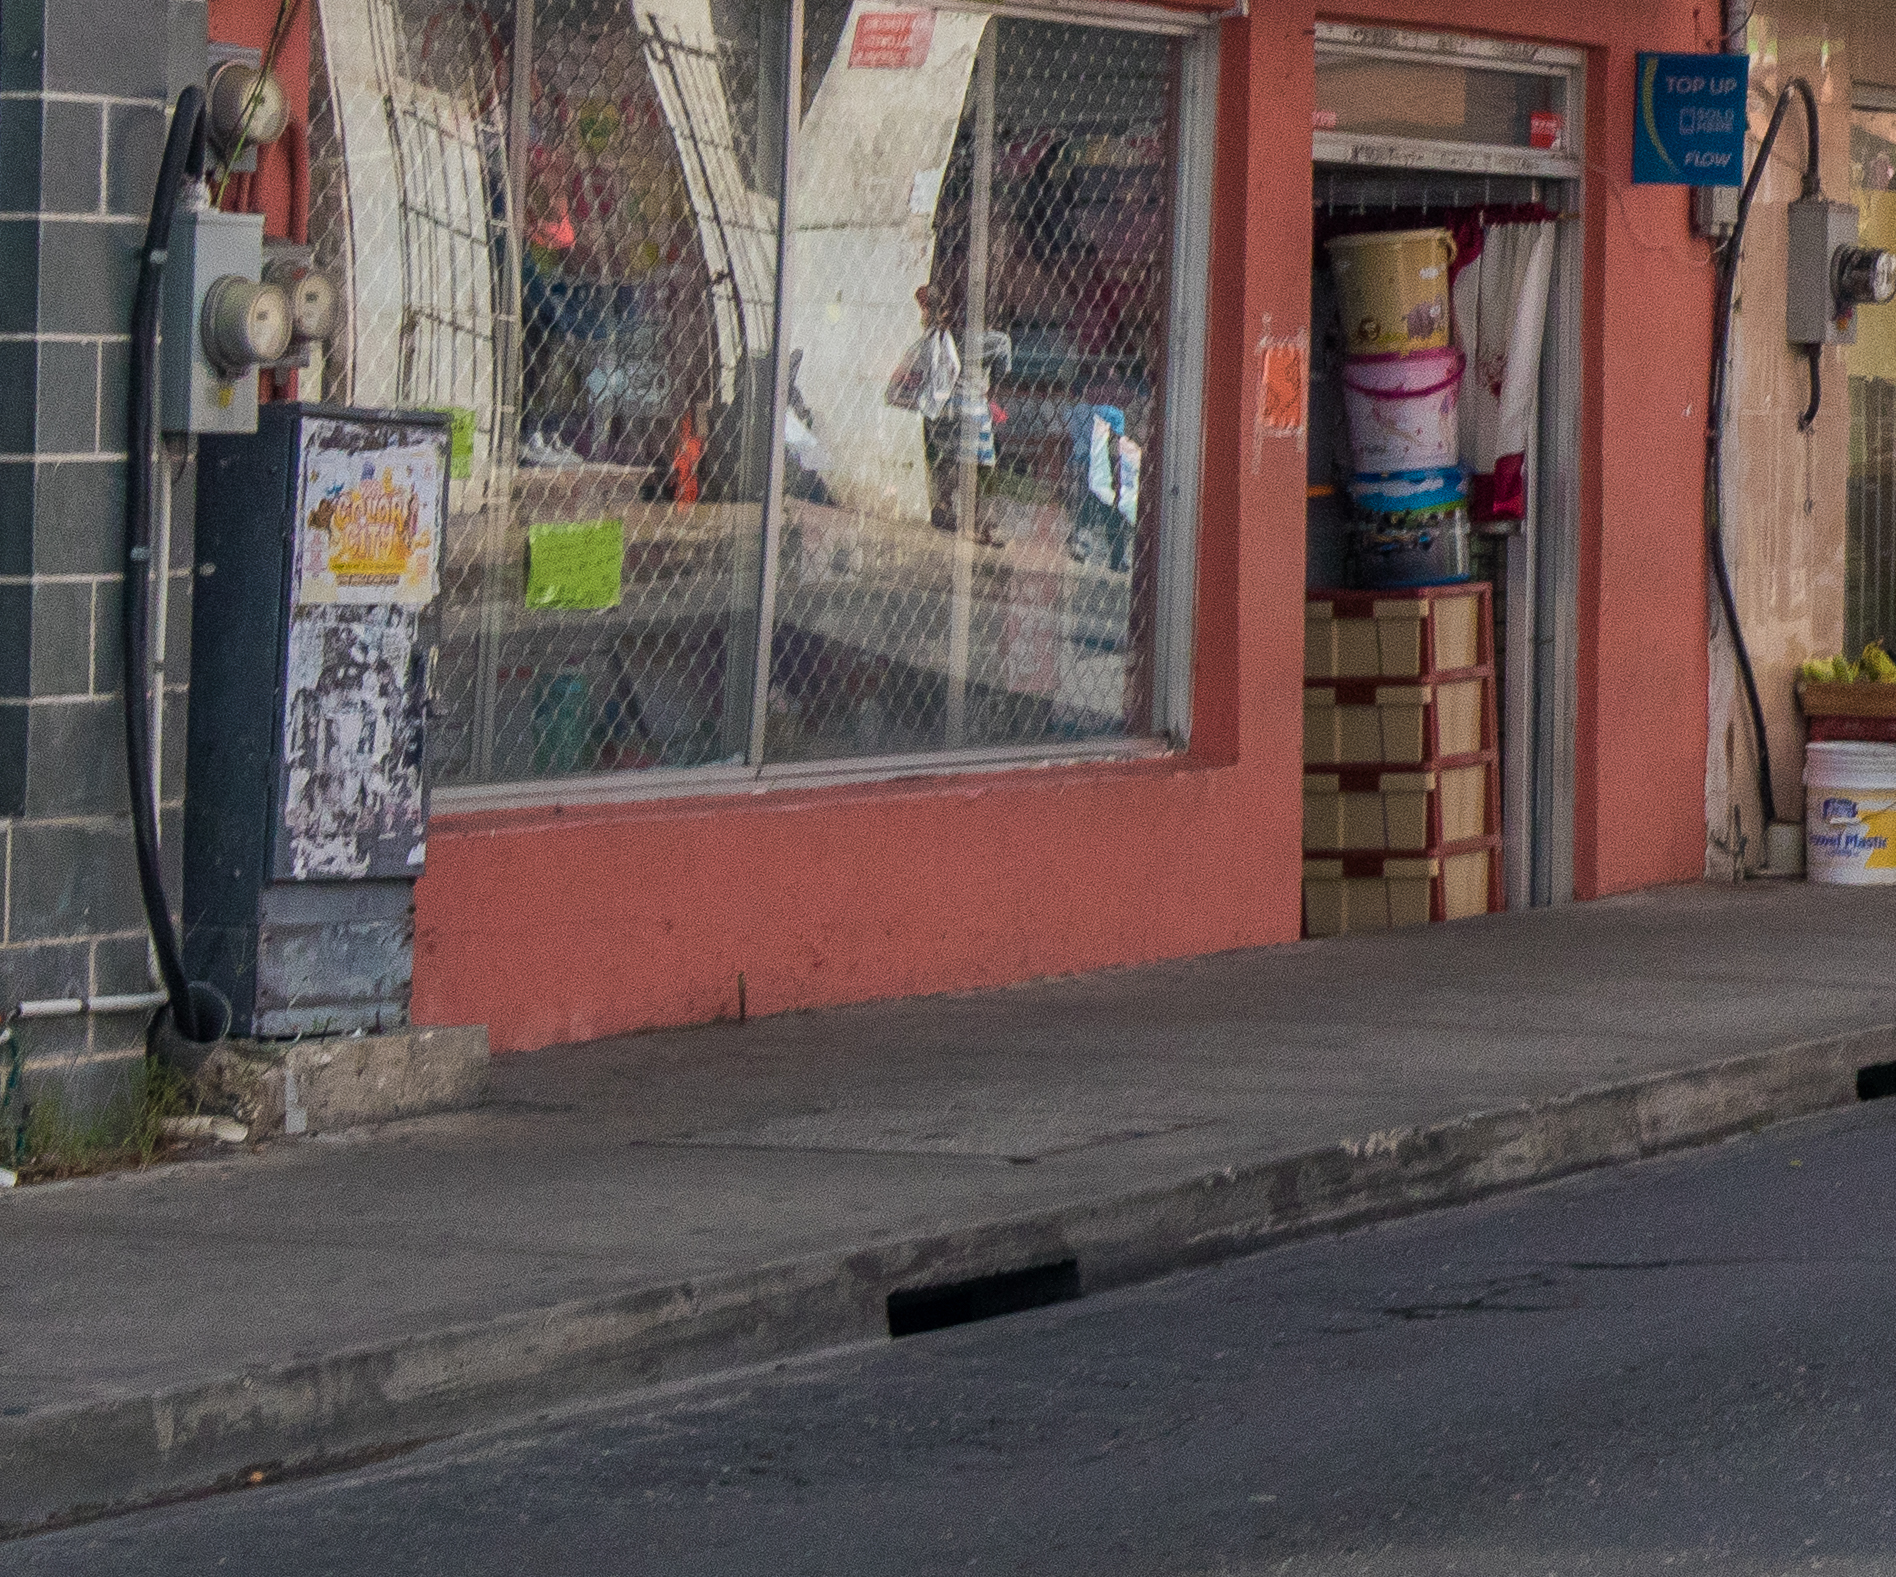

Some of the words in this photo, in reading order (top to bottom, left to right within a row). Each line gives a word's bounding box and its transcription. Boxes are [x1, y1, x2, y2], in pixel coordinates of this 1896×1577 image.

[1665, 76, 1705, 94] TOP
[1709, 77, 1738, 95] UP
[1684, 151, 1733, 167] FLOW
